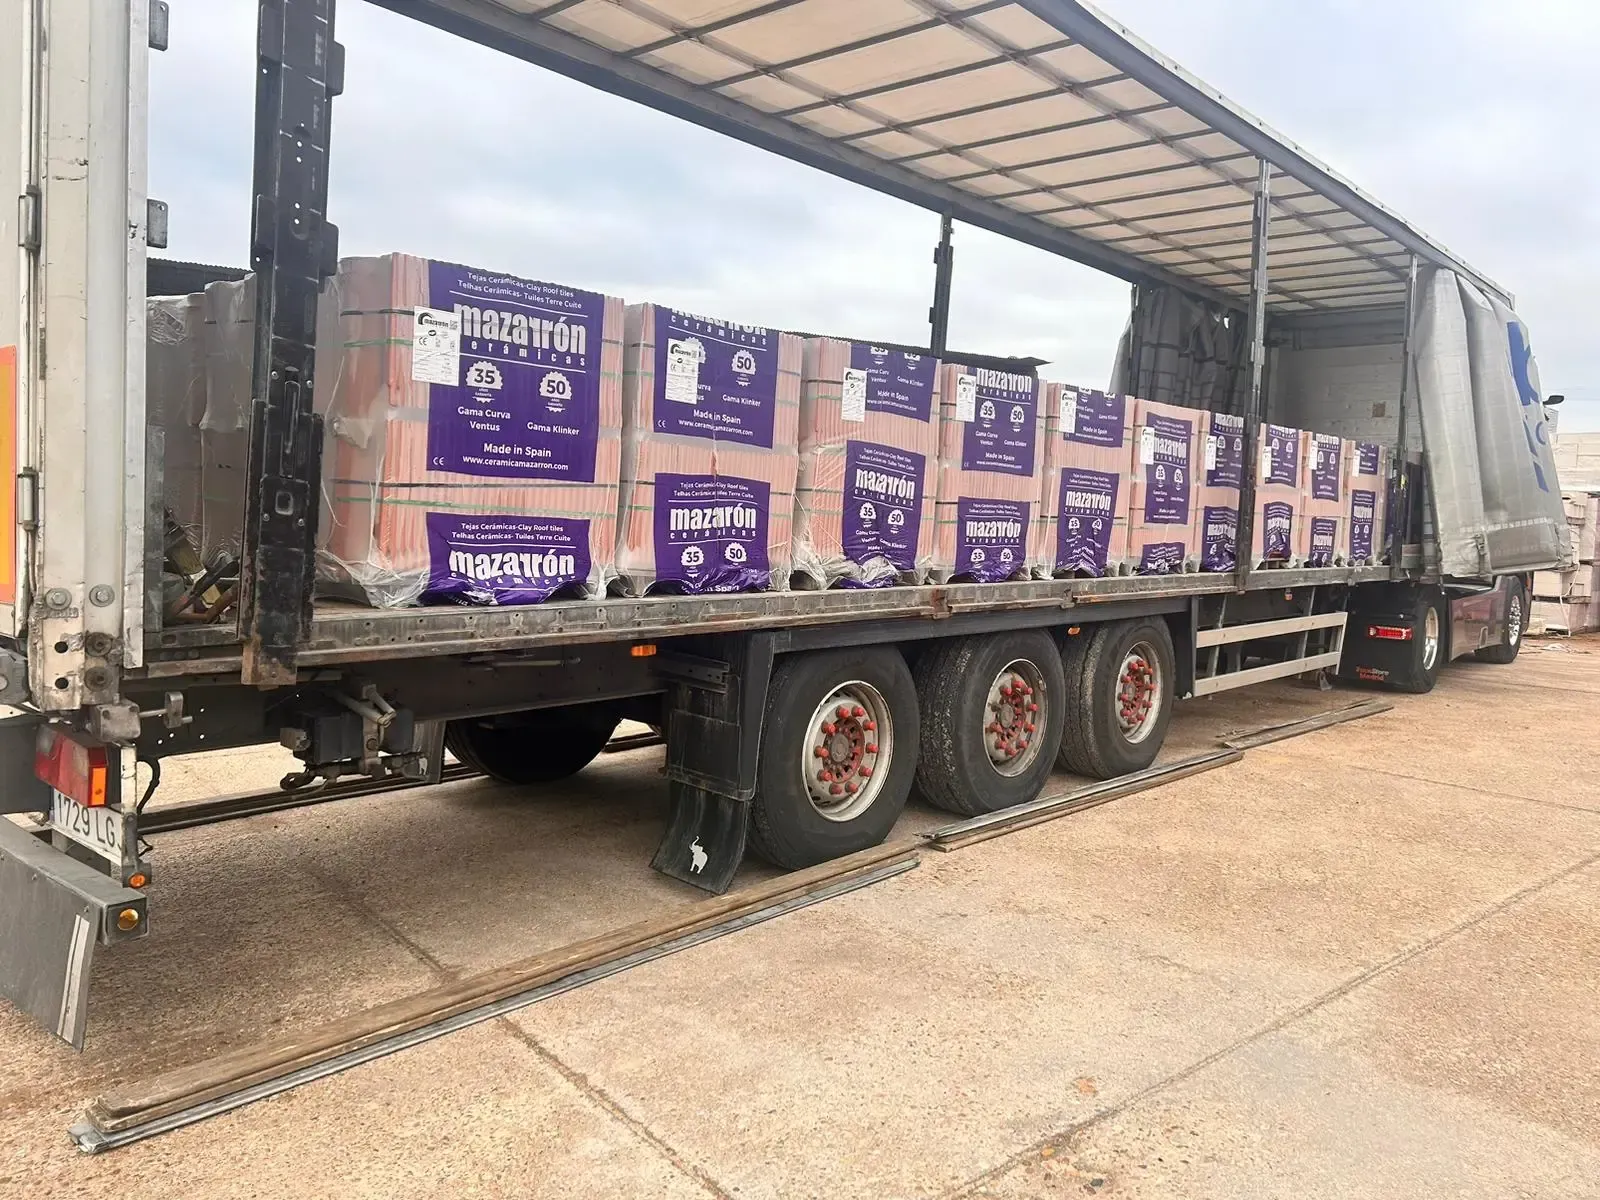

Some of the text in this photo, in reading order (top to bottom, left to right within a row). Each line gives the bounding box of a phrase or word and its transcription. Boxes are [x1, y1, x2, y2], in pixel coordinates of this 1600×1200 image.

[467, 271, 487, 283] Tejas
[542, 285, 558, 296] Roof
[559, 288, 574, 298] tiles
[458, 279, 482, 291] Telhas
[523, 292, 545, 303] Tuiles
[545, 296, 563, 307] Terre
[564, 300, 582, 309] Cuite
[471, 341, 586, 367] erámicas
[736, 356, 751, 370] 50
[474, 368, 495, 385] 35
[546, 379, 566, 396] 50
[697, 383, 712, 392] urva
[722, 394, 740, 404] Gama
[457, 406, 511, 419] Gama Curva
[693, 409, 741, 425] Made in Spain
[983, 406, 993, 416] 35
[1012, 411, 1022, 421] 50
[469, 421, 500, 432] Ventus
[527, 421, 580, 436] Gama Klinker
[483, 443, 551, 458] Made in Spain
[462, 455, 569, 471] www.ceramicamazarron.com
[863, 507, 873, 517] 35
[890, 513, 901, 524] 50
[461, 522, 479, 531] Tejas
[452, 531, 475, 539] Telhas
[515, 532, 534, 540] Tuiles
[535, 533, 552, 541] Terre
[553, 534, 571, 542] Cuite
[686, 551, 700, 563] 35
[729, 549, 743, 560] 50
[58, 793, 122, 850] 1729 LG
